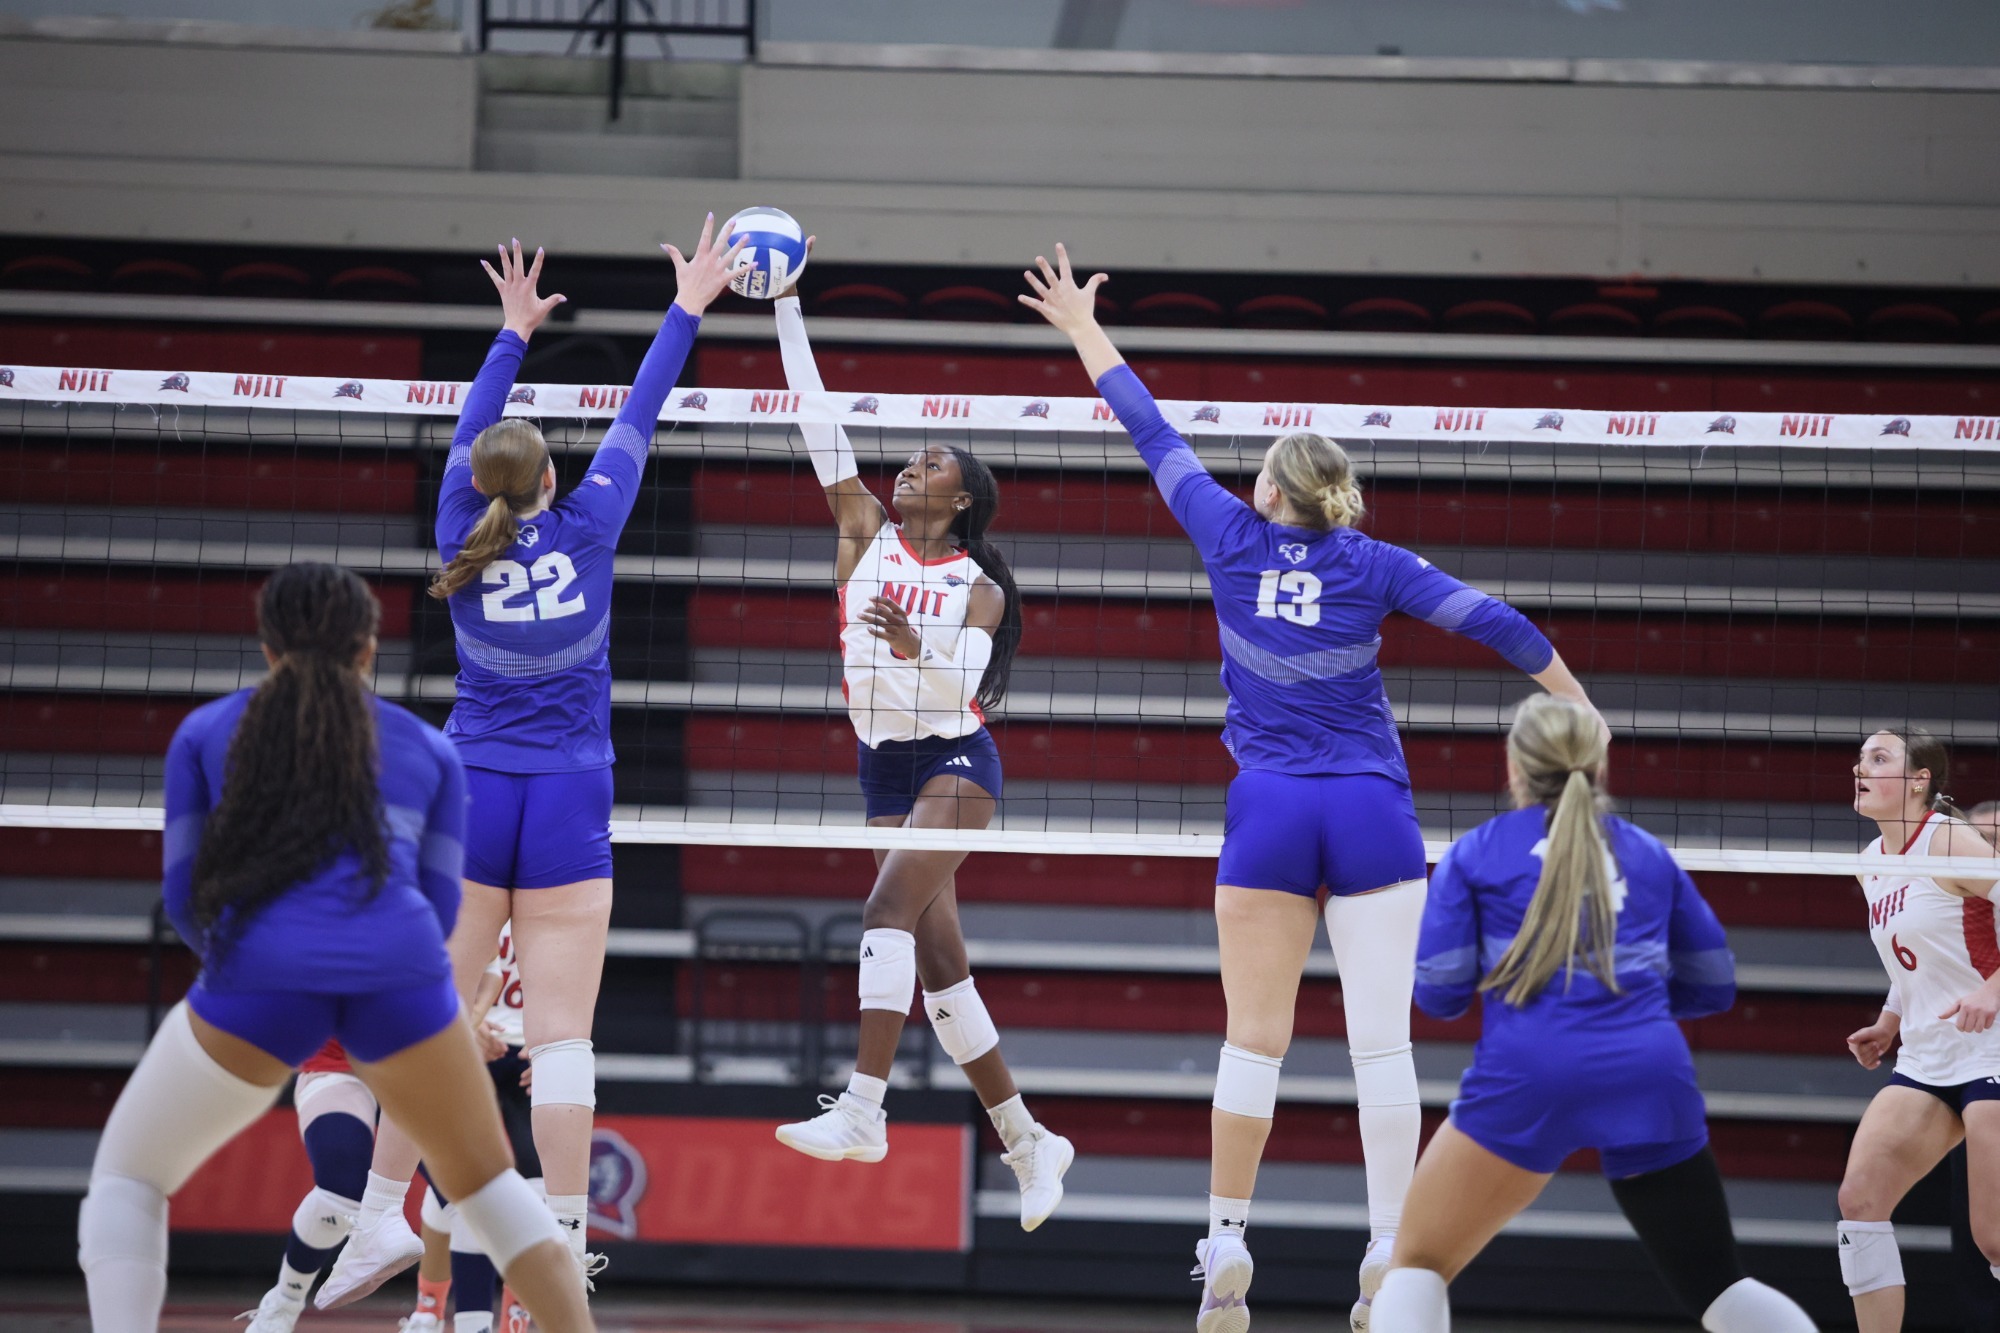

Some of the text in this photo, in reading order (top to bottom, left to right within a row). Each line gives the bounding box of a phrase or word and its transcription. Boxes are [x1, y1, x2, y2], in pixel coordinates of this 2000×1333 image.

[59, 369, 113, 392] NJIT
[233, 375, 287, 398] NJIT
[406, 382, 460, 405] NJIT
[750, 392, 804, 414] NJIT
[921, 396, 975, 418] NJIT
[1263, 405, 1315, 427] NJIT
[1434, 408, 1488, 432] NJIT
[1607, 413, 1660, 436] NJIT
[1780, 415, 1834, 438] NJIT
[481, 551, 586, 622] 22
[881, 581, 949, 617] NJIT
[1254, 570, 1322, 627] 13
[1871, 884, 1910, 930] NJIT
[1892, 933, 1917, 971] 6
